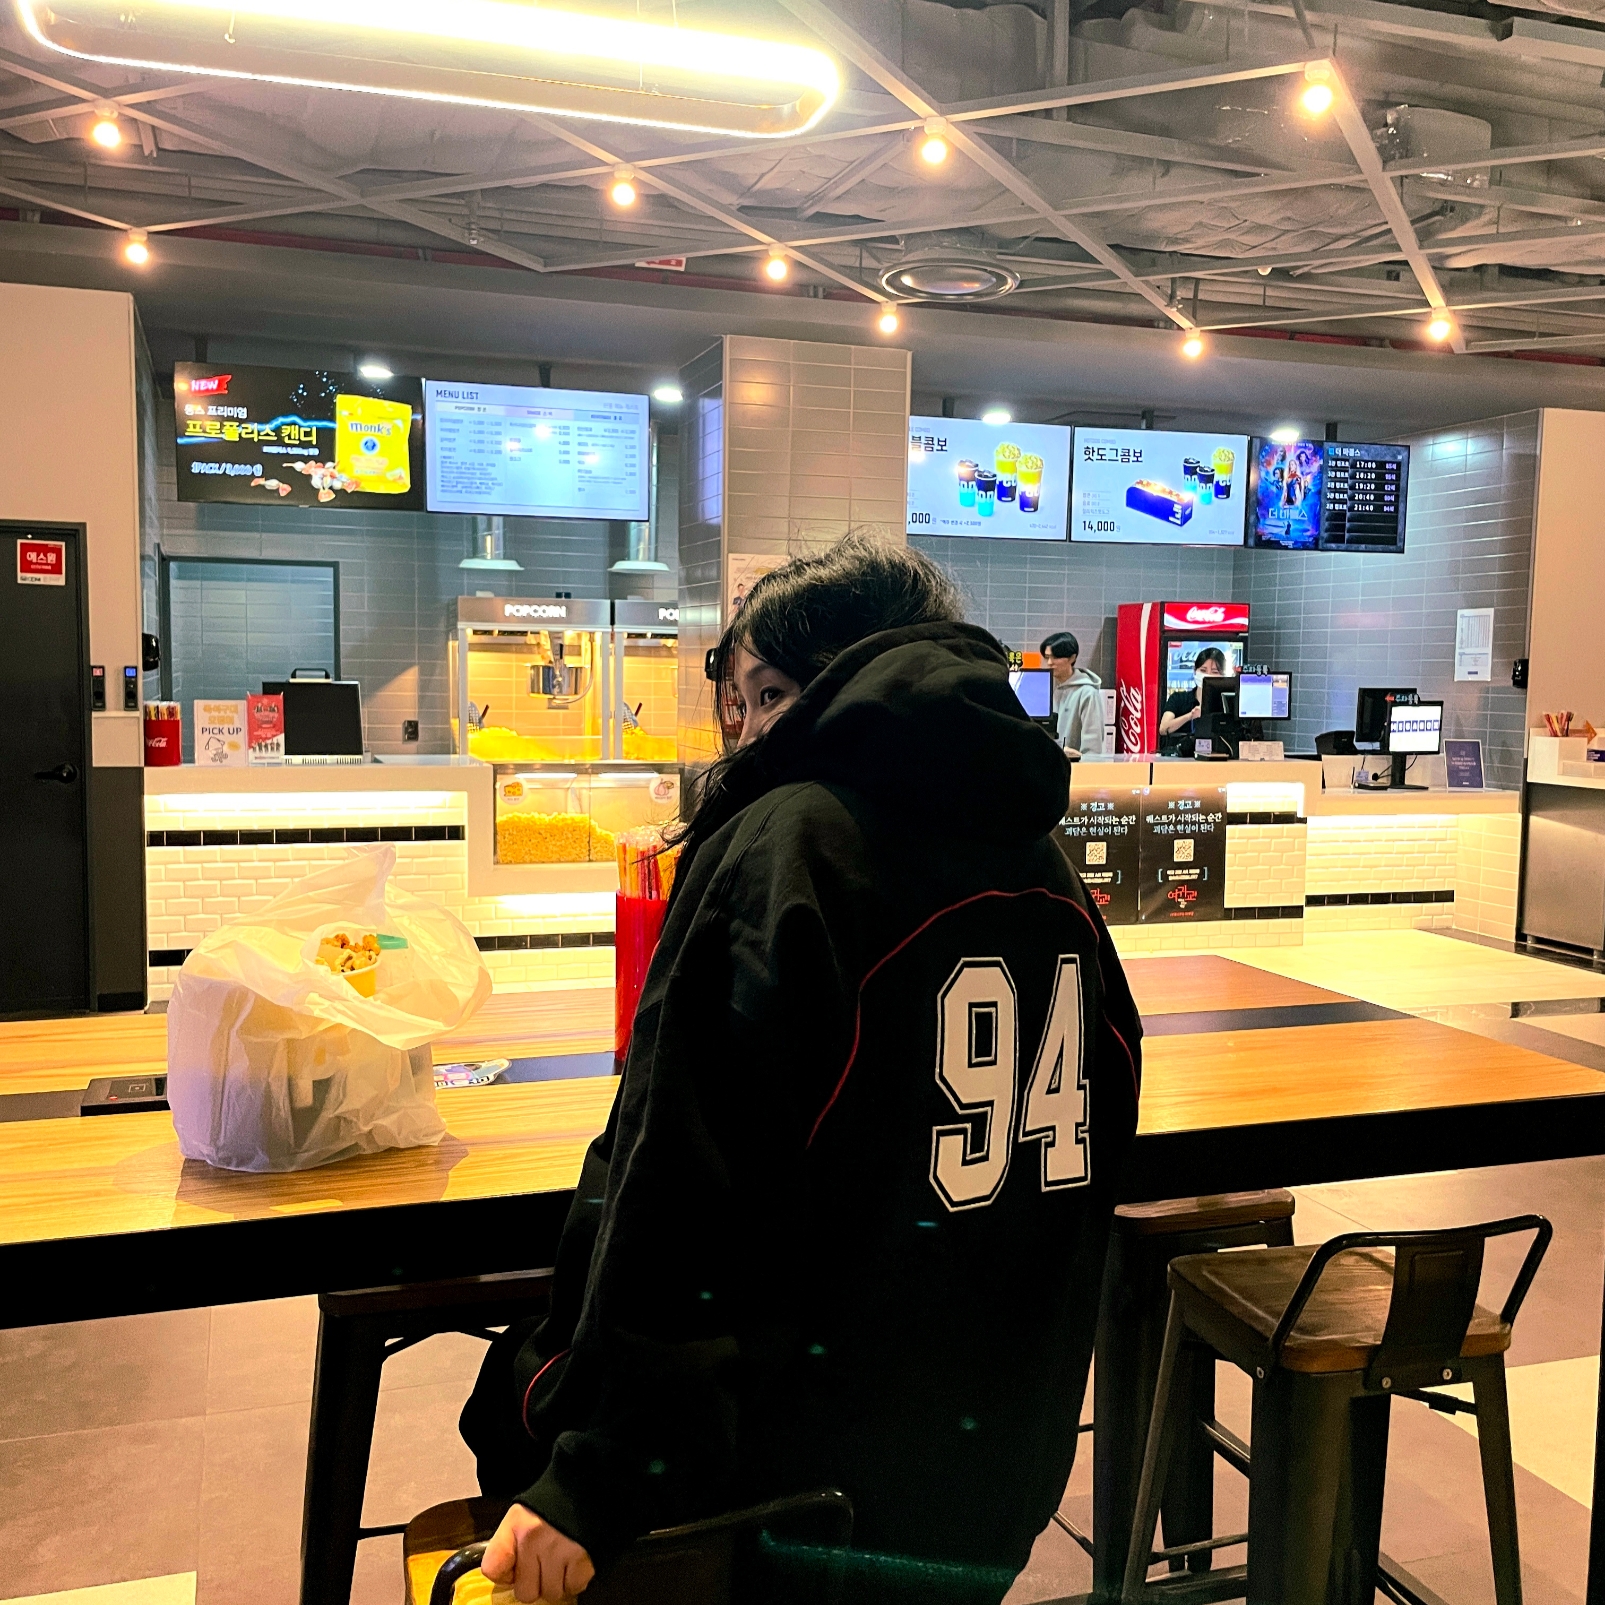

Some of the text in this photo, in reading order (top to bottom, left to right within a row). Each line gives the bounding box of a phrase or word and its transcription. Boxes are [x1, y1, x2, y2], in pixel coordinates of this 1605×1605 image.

[191, 380, 218, 391] NEW
[436, 390, 479, 400] MENU LIST
[207, 406, 247, 419] 프리미엄
[185, 420, 317, 445] 프로폴리스 캔디
[910, 435, 948, 452] 블콤보
[1084, 446, 1143, 463] 핫도그콤보
[908, 512, 930, 525] ,000
[1269, 508, 1277, 518] 더
[1083, 520, 1115, 533] 14,000
[27, 552, 56, 564] 에스원
[504, 604, 566, 618] POPCORN
[202, 727, 242, 735] PICK UP
[1090, 802, 1105, 812] 경고
[1178, 800, 1192, 810] 경고
[1089, 815, 1119, 825] 시작되는
[1120, 815, 1136, 825] 순간
[1146, 812, 1222, 823] 퀘스트가 시작되는 순간
[1065, 826, 1128, 836] 괴담은 현실이 된다
[1153, 823, 1214, 834] 괴담은 현실이 된다
[929, 954, 1091, 1212] 94
